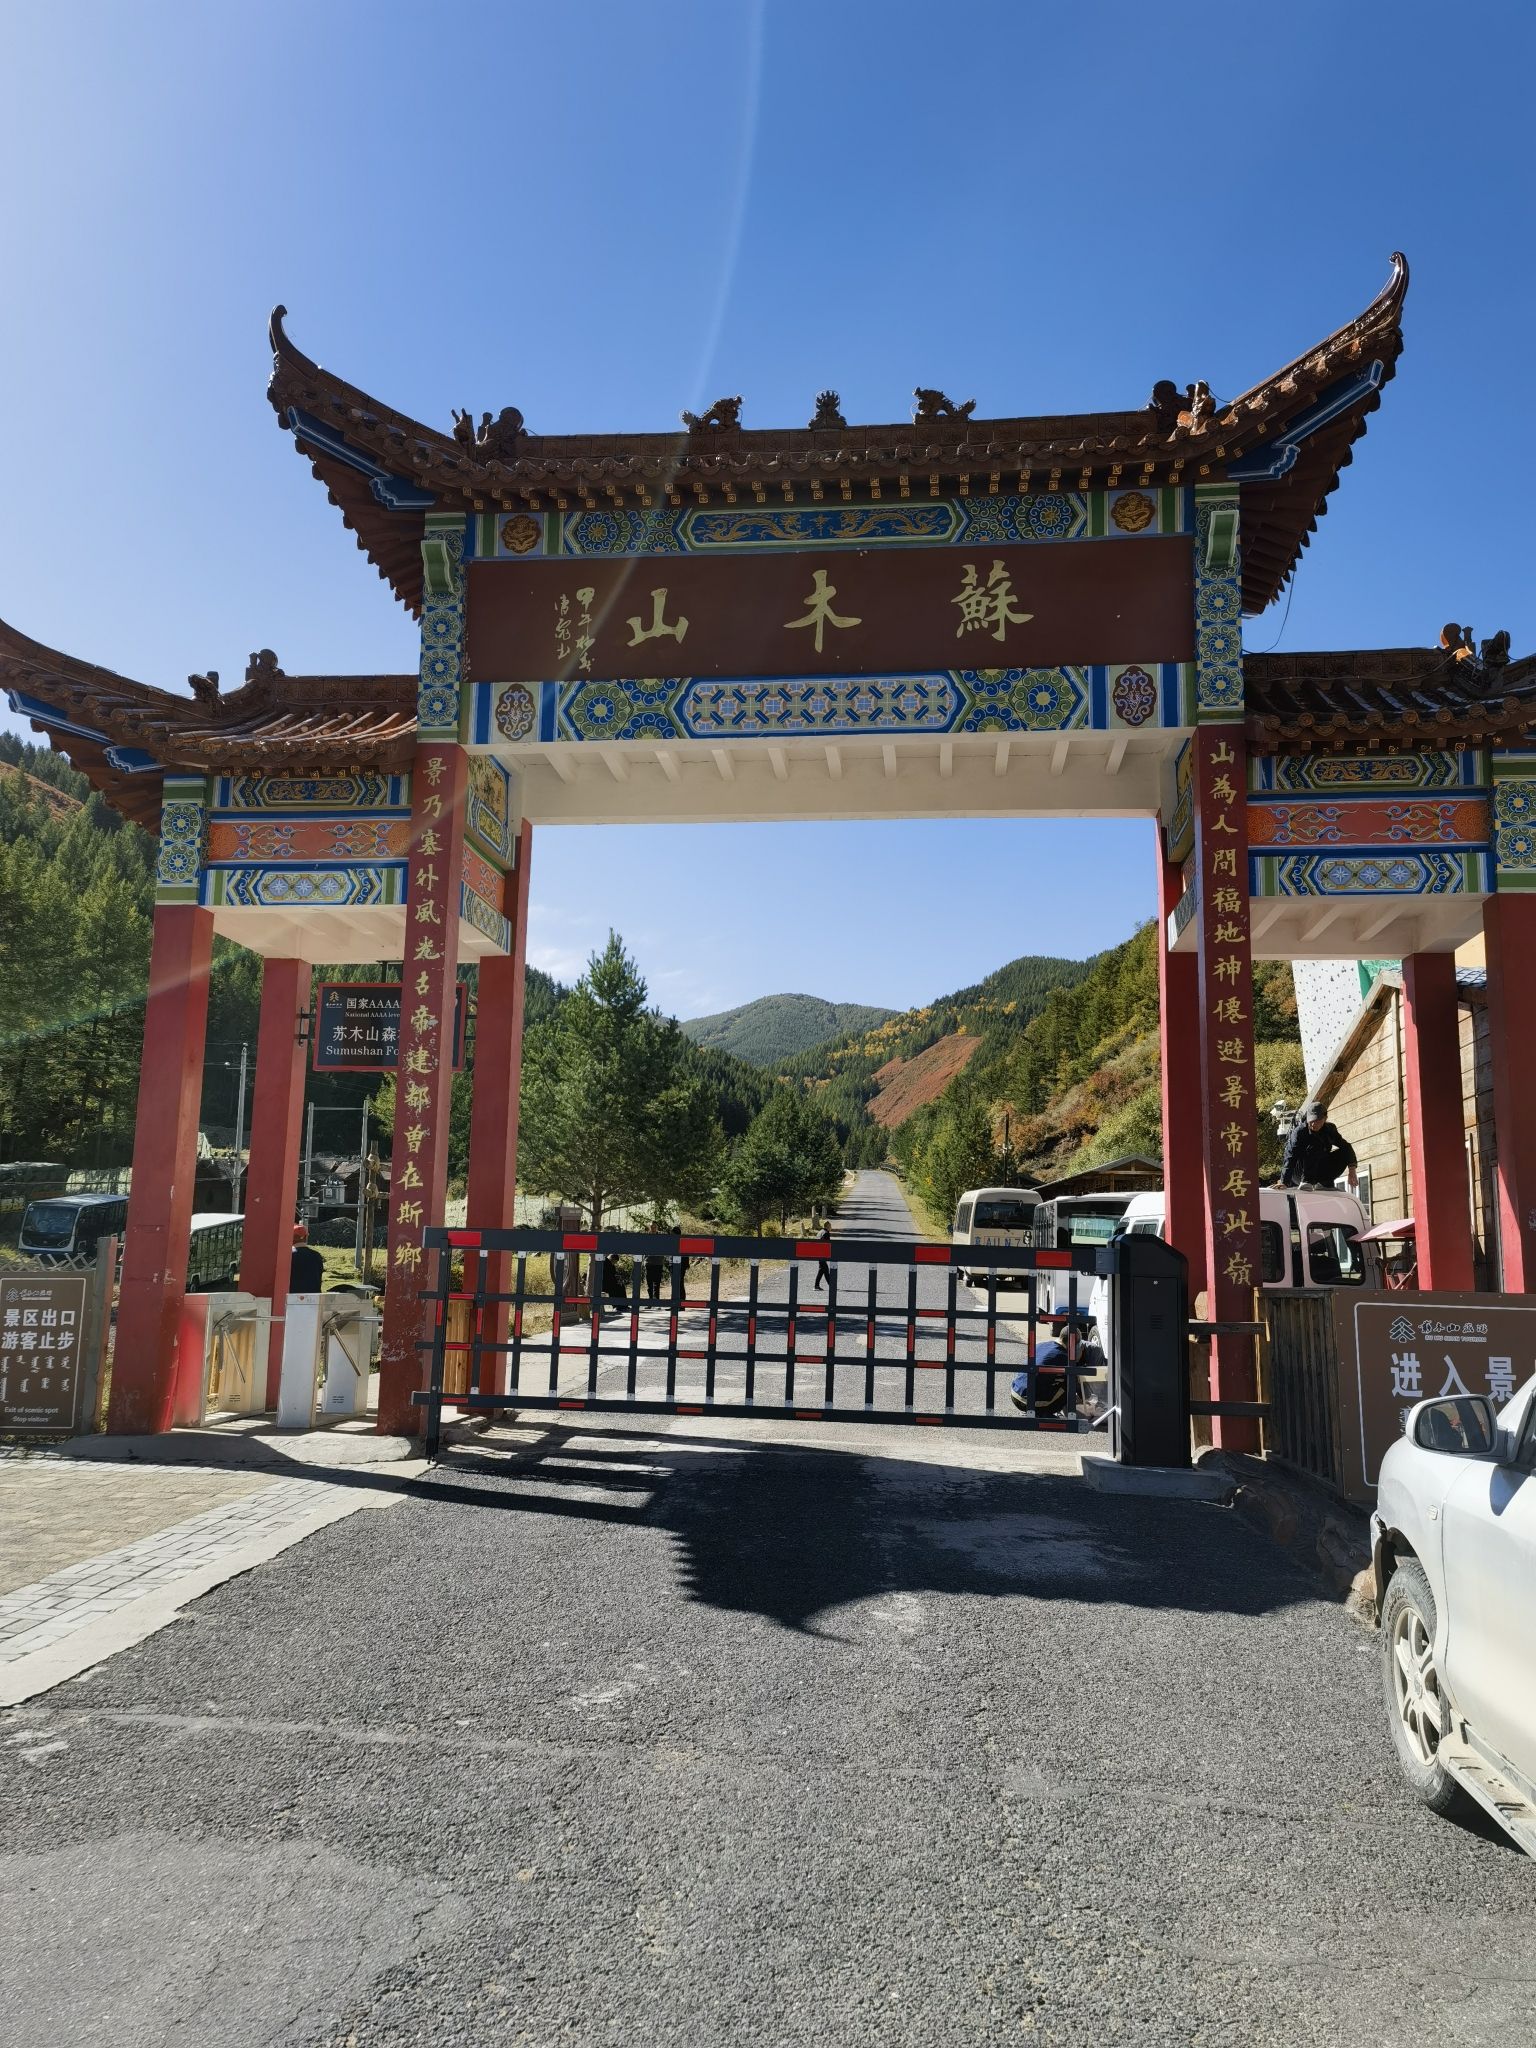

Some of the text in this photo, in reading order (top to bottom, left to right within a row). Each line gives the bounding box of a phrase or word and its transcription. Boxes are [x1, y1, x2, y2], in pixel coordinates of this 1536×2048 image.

[346, 997, 402, 1010] 国家AAAA
[332, 1025, 401, 1043] 苏木山森
[325, 1045, 384, 1056] Sumushan
[4, 1308, 76, 1327] 景区出口
[1, 1331, 75, 1350] 游客止步
